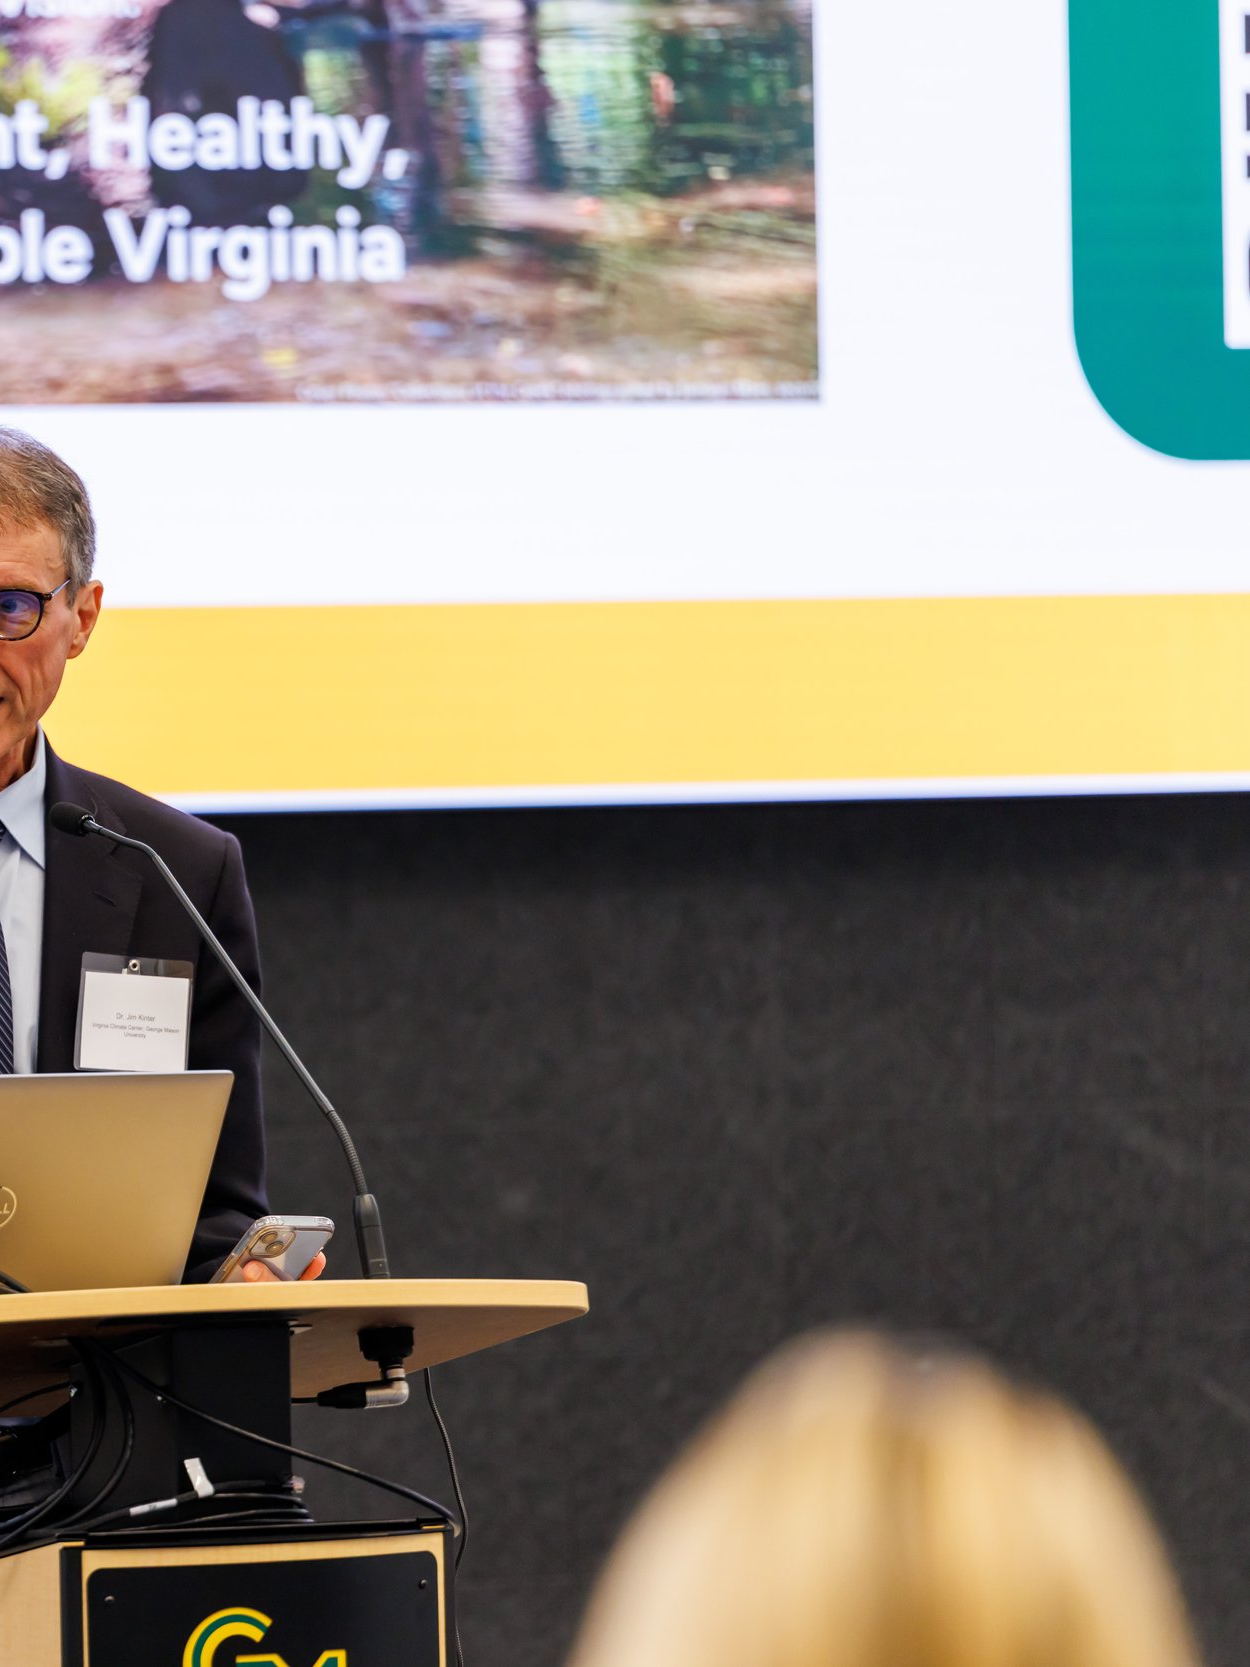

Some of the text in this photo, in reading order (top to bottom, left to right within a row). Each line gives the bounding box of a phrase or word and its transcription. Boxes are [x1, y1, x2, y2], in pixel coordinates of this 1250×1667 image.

[88, 95, 410, 189] Healthy,
[105, 207, 407, 303] Virginia
[126, 1013, 137, 1021] Jim
[138, 1014, 156, 1022] Kinter
